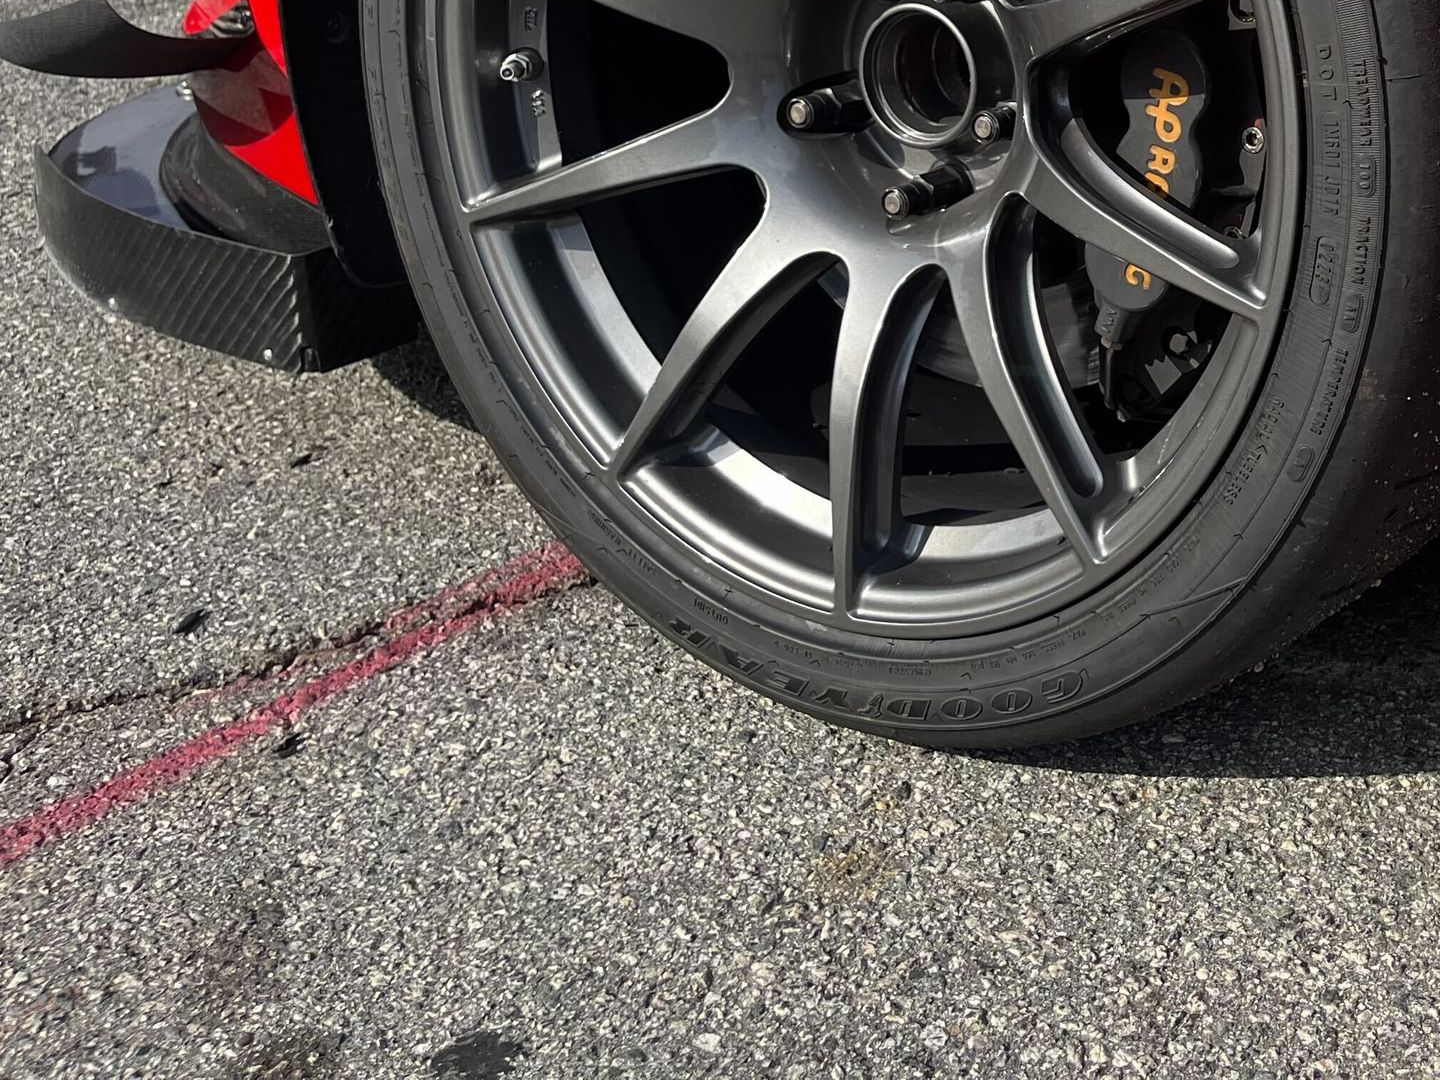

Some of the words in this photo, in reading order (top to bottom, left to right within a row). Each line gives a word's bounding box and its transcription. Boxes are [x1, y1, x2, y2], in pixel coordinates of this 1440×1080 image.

[1316, 44, 1338, 102] DOT
[1352, 59, 1375, 148] TREADWEAR
[1349, 216, 1371, 286] TRACTION
[668, 619, 1083, 720] GOODYEAR
